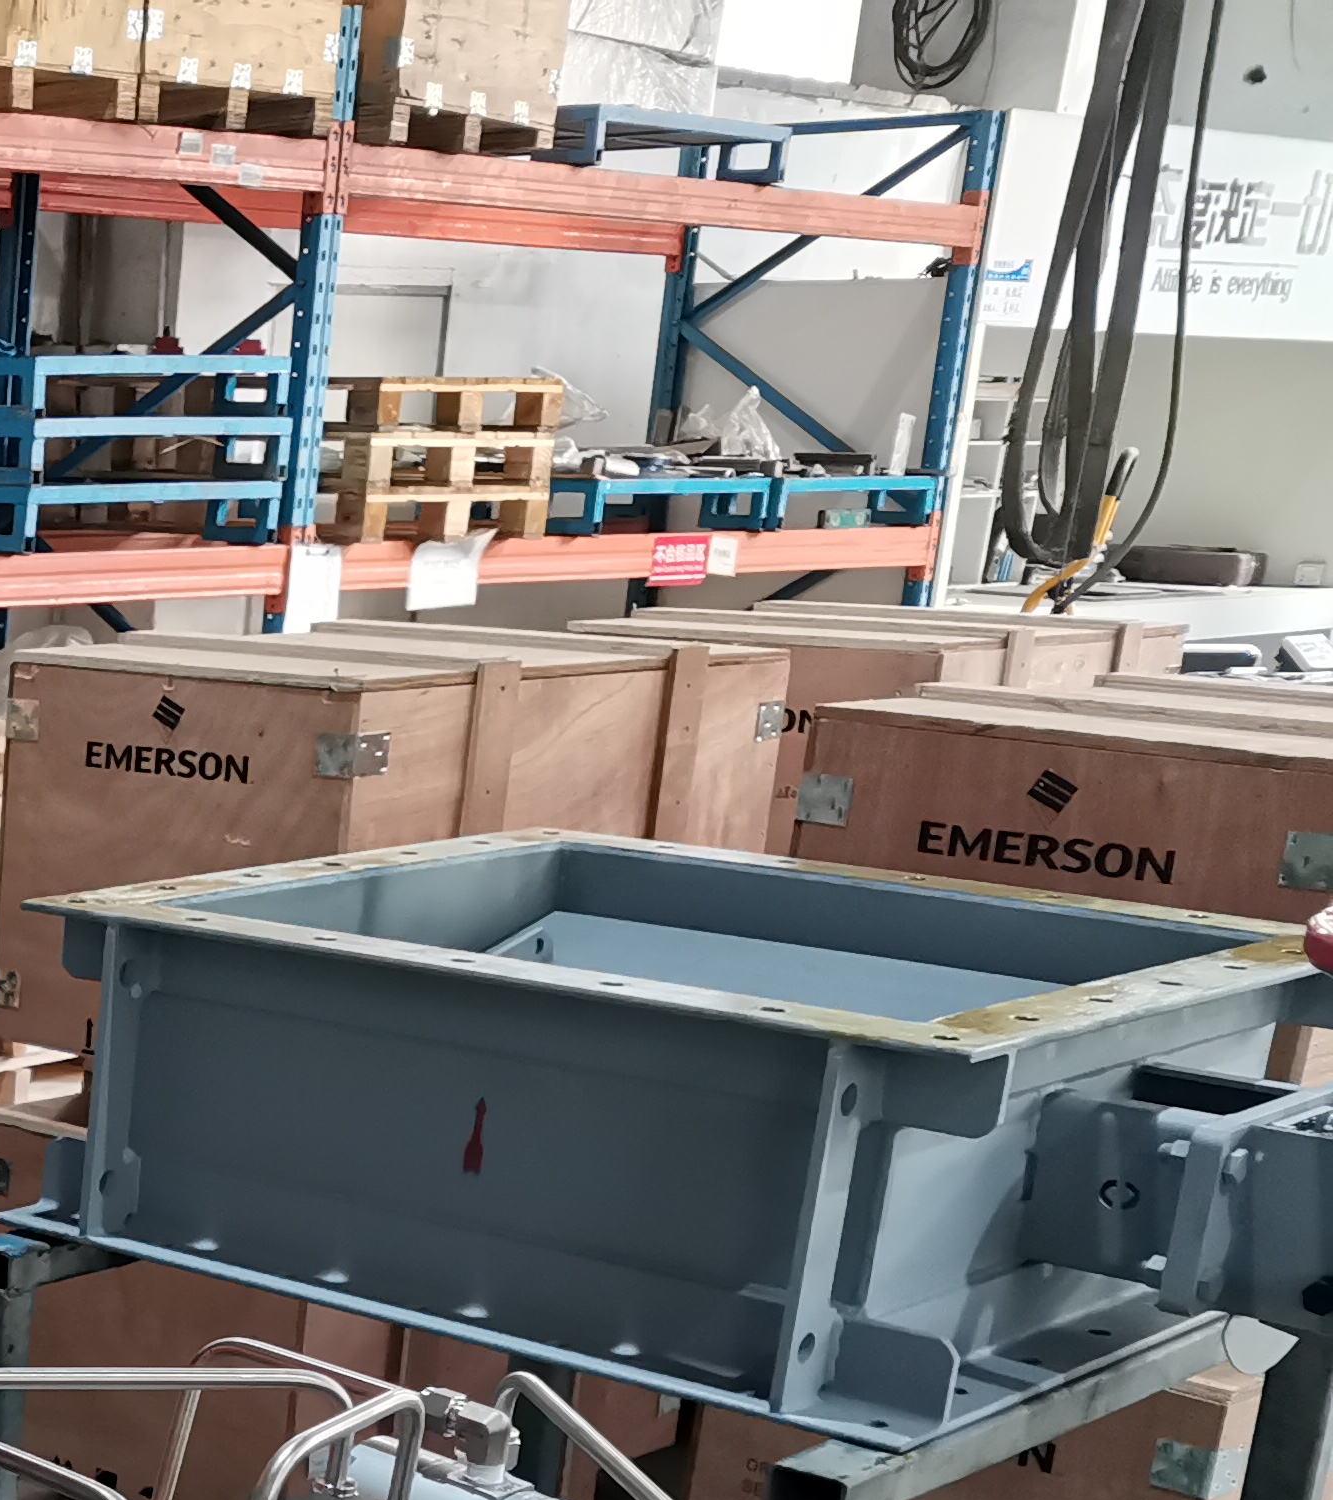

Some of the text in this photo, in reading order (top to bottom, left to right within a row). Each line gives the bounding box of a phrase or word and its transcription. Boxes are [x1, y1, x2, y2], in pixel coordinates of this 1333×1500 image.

[1208, 268, 1223, 295] is
[1226, 270, 1294, 304] everything
[85, 740, 250, 785] EMERSON
[916, 820, 1177, 885] EMERSON
